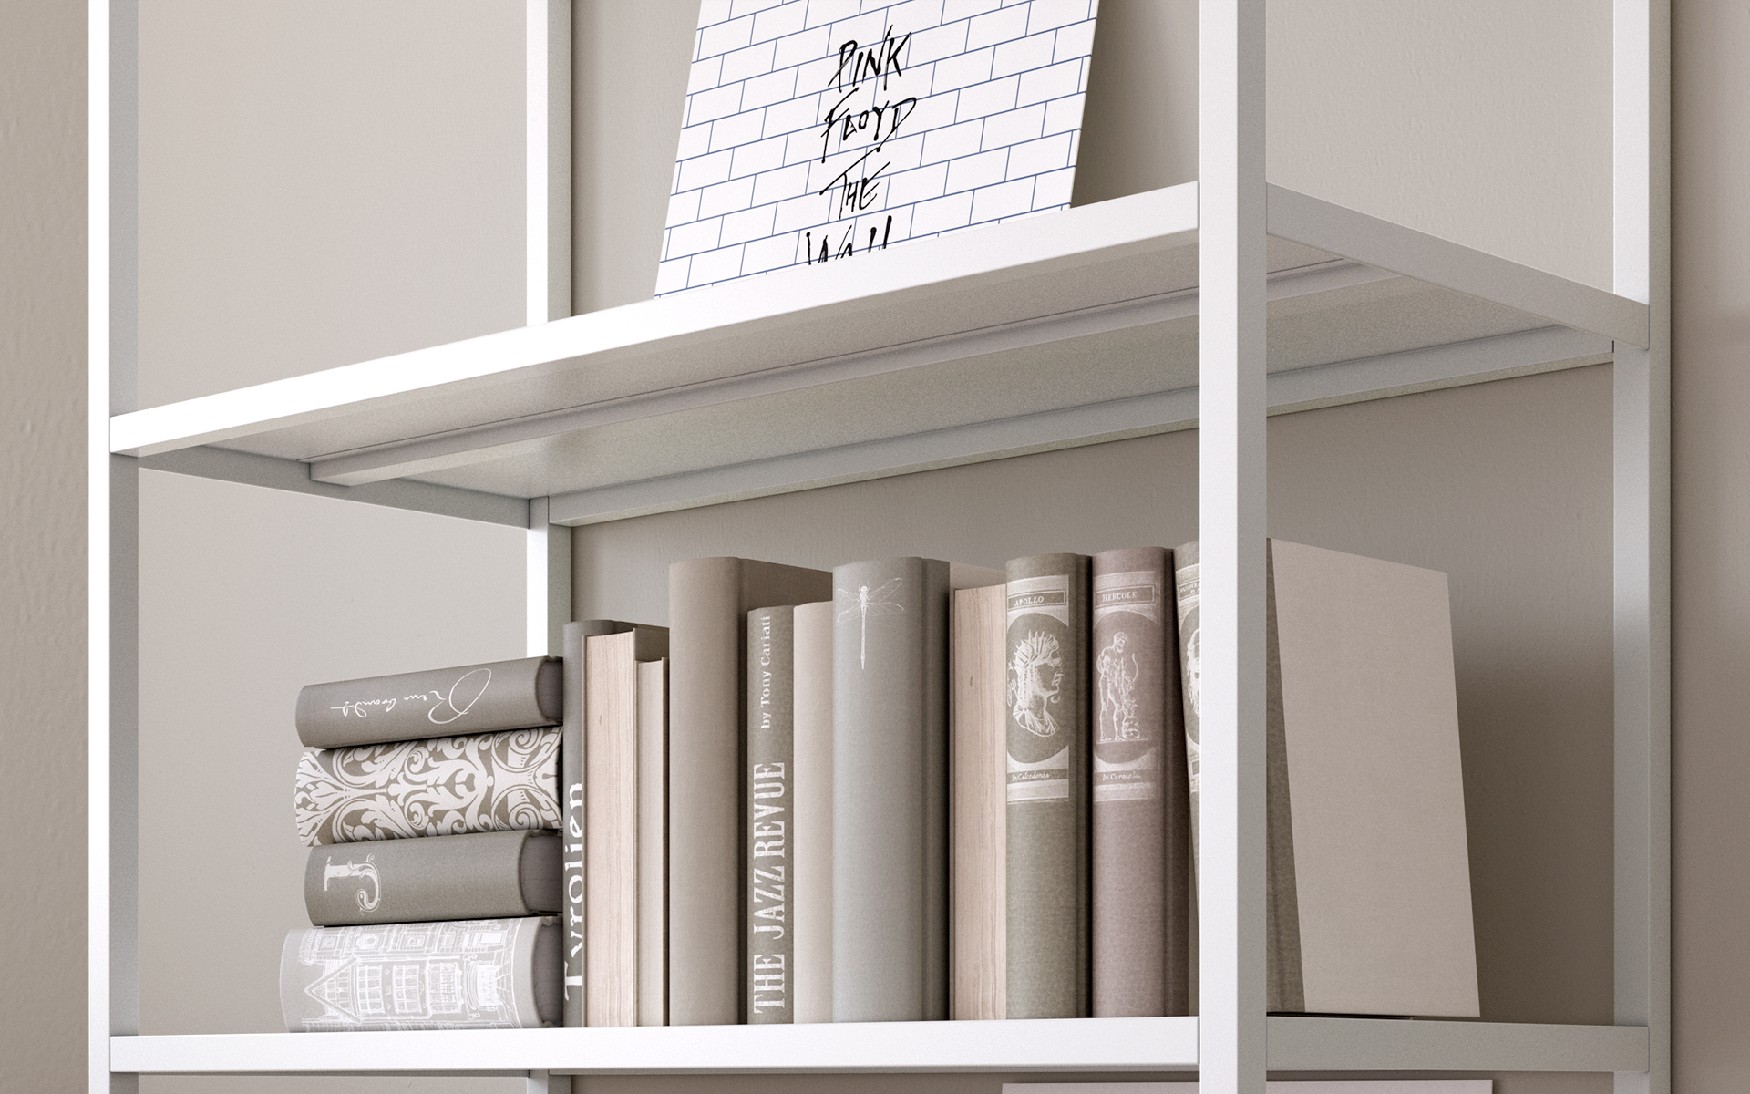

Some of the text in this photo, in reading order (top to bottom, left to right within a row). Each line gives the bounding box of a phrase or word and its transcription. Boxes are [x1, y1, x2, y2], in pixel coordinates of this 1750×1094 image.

[828, 24, 912, 93] PINK
[821, 87, 918, 164] FLOYD
[819, 147, 891, 220] THE
[760, 670, 772, 708] Tony
[760, 711, 772, 730] by
[753, 761, 786, 1014] THE JAZZ REVUE
